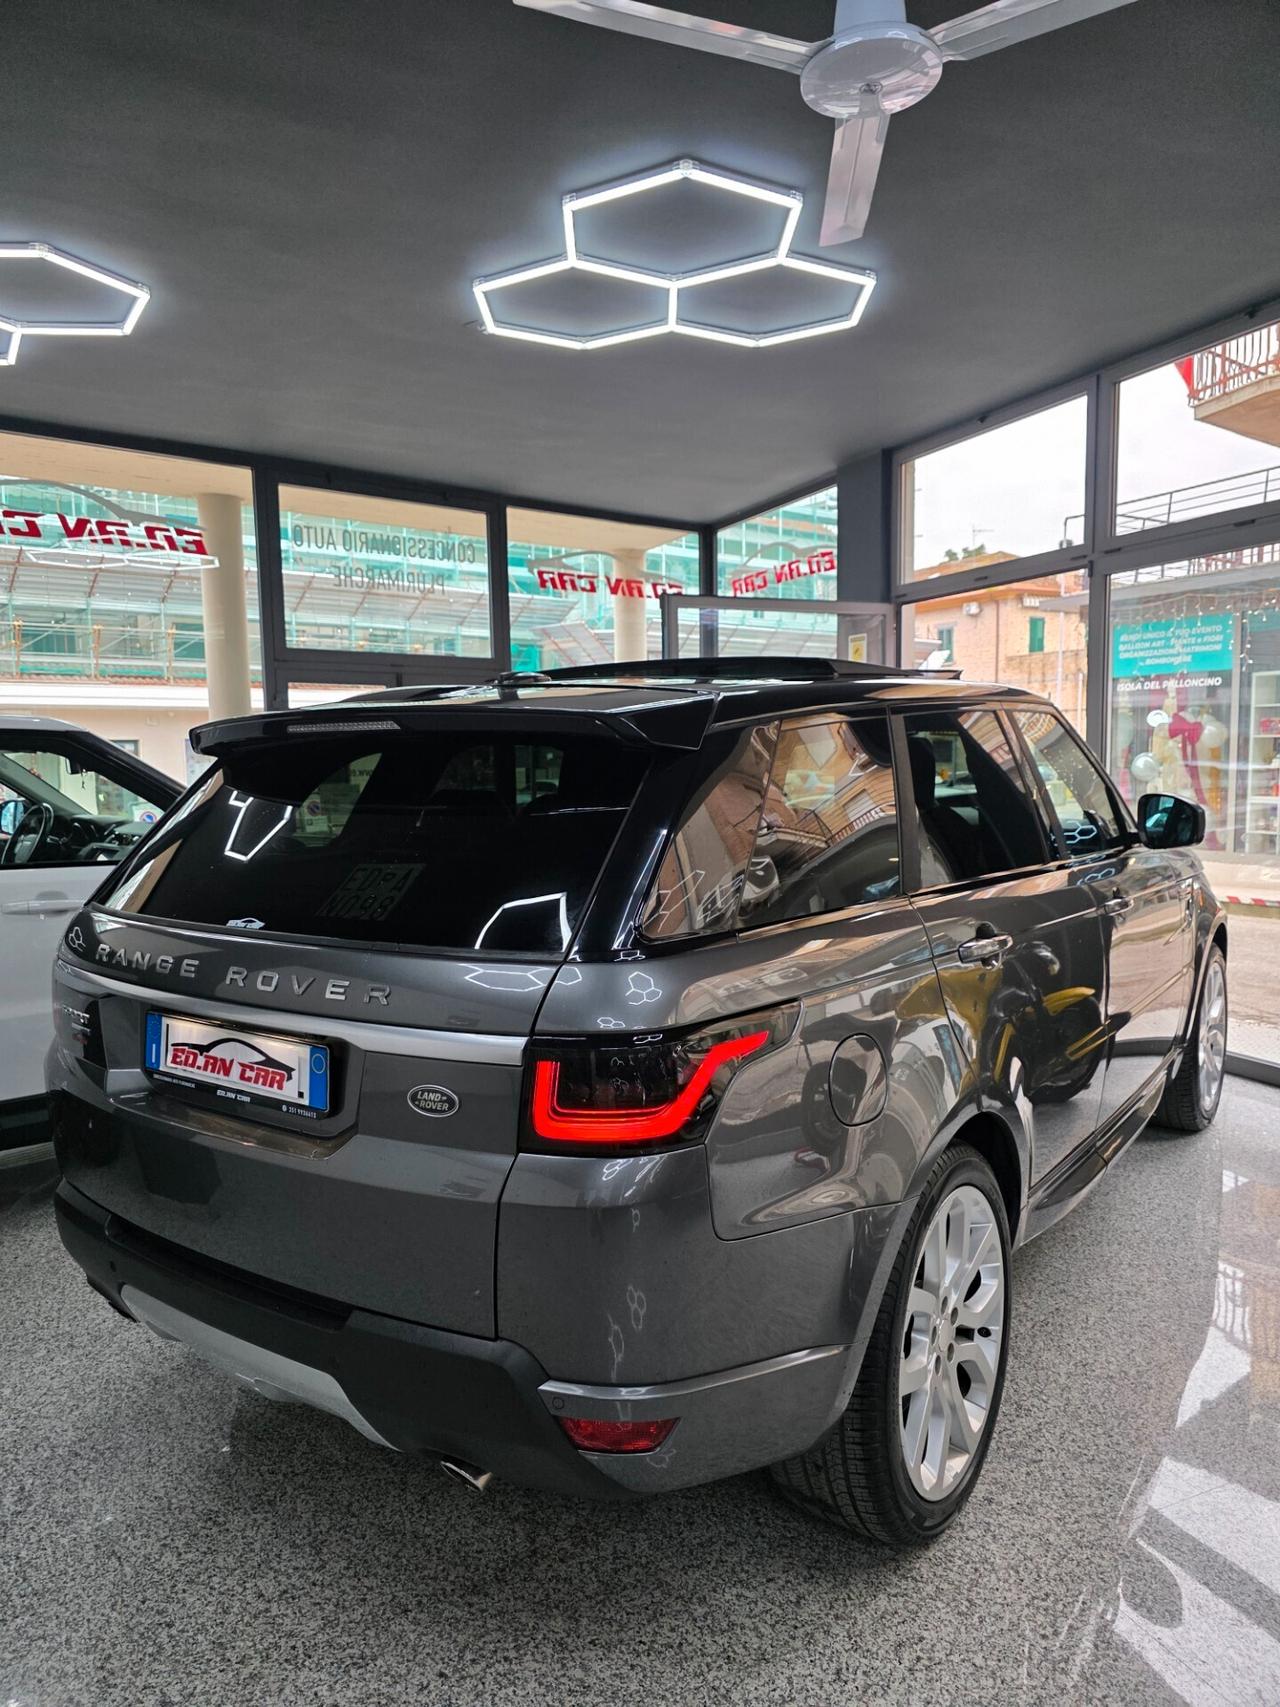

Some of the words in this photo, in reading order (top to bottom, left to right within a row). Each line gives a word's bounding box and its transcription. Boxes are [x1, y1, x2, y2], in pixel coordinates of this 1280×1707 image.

[1192, 625, 1222, 636] EVENTO
[1117, 681, 1142, 692] ISOLA
[1144, 680, 1161, 690] DEL
[95, 943, 200, 979] RANGE
[226, 965, 393, 1006] ROVER
[238, 1061, 287, 1091] CAR
